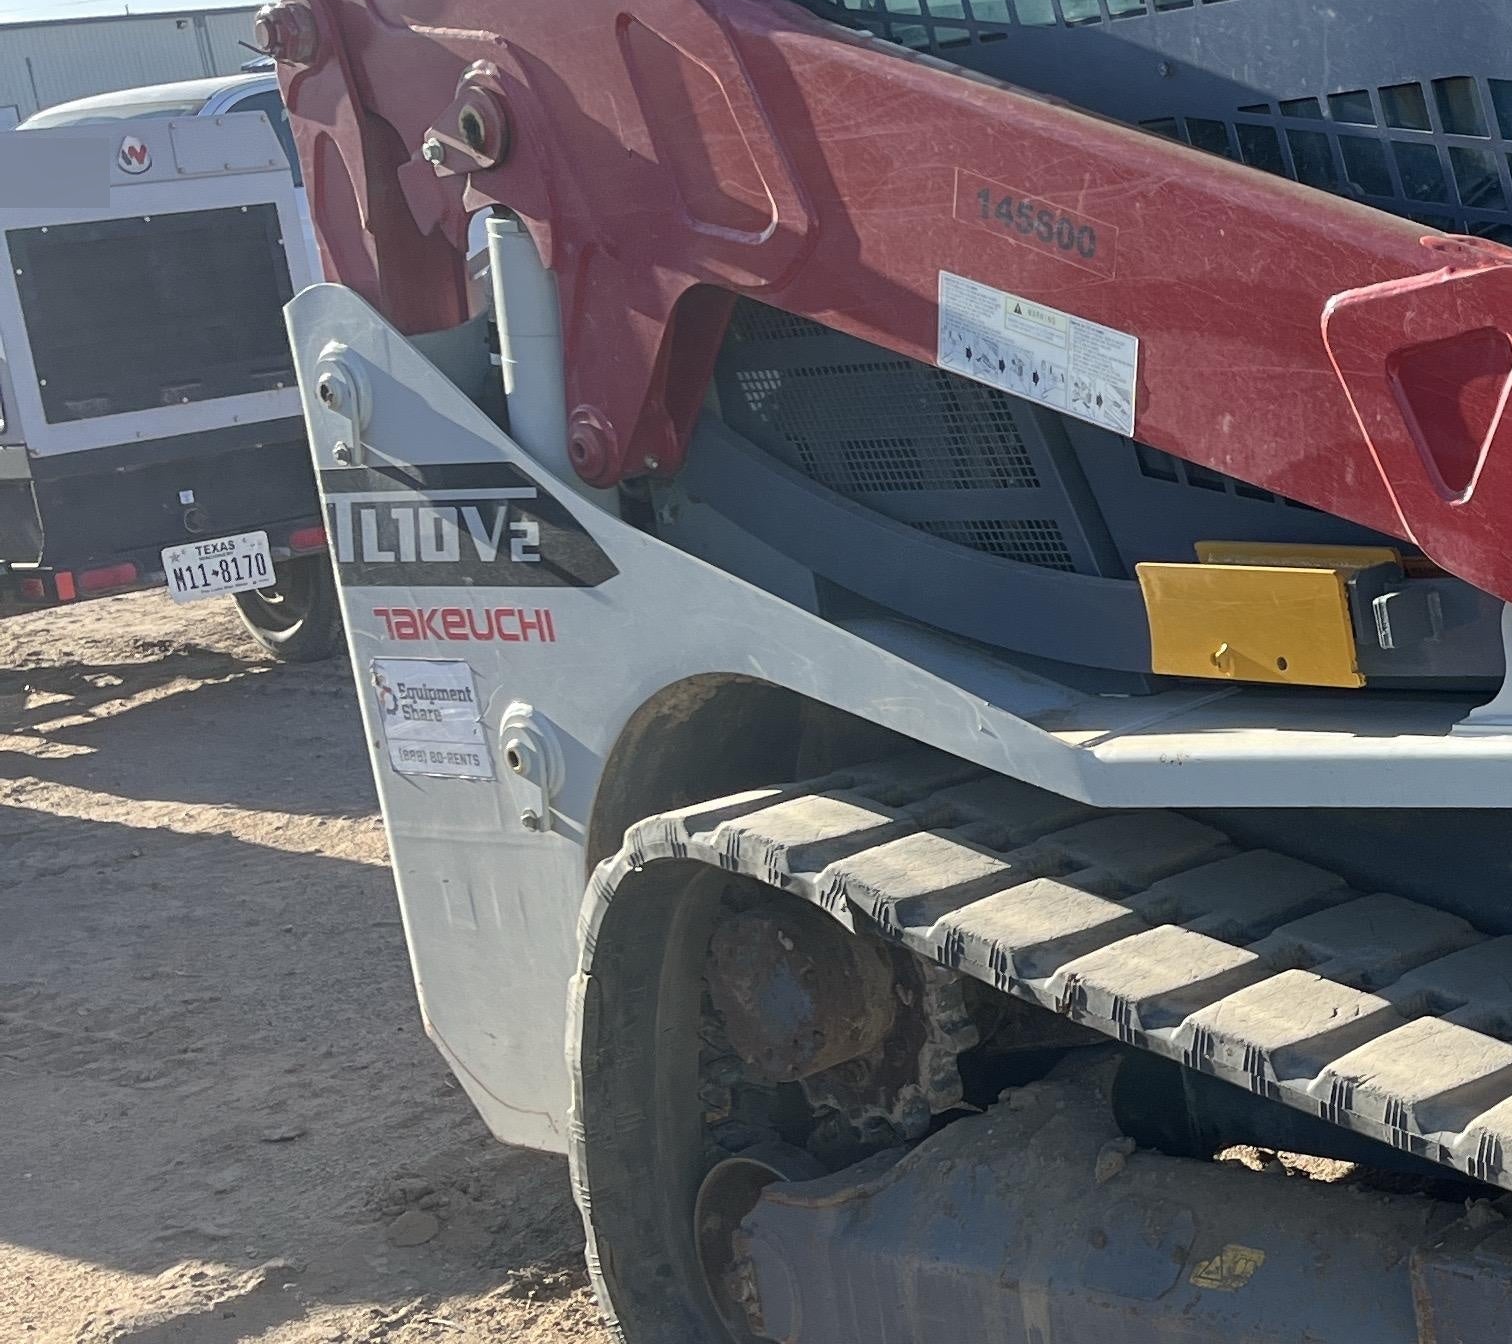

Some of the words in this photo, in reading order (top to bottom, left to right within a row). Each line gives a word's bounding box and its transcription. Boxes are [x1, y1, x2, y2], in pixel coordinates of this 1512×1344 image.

[976, 186, 1097, 260] 145500
[194, 539, 236, 556] TEXAS
[373, 608, 557, 642] TAKEUCHI
[397, 682, 474, 705] Equipment
[401, 704, 443, 723] Share
